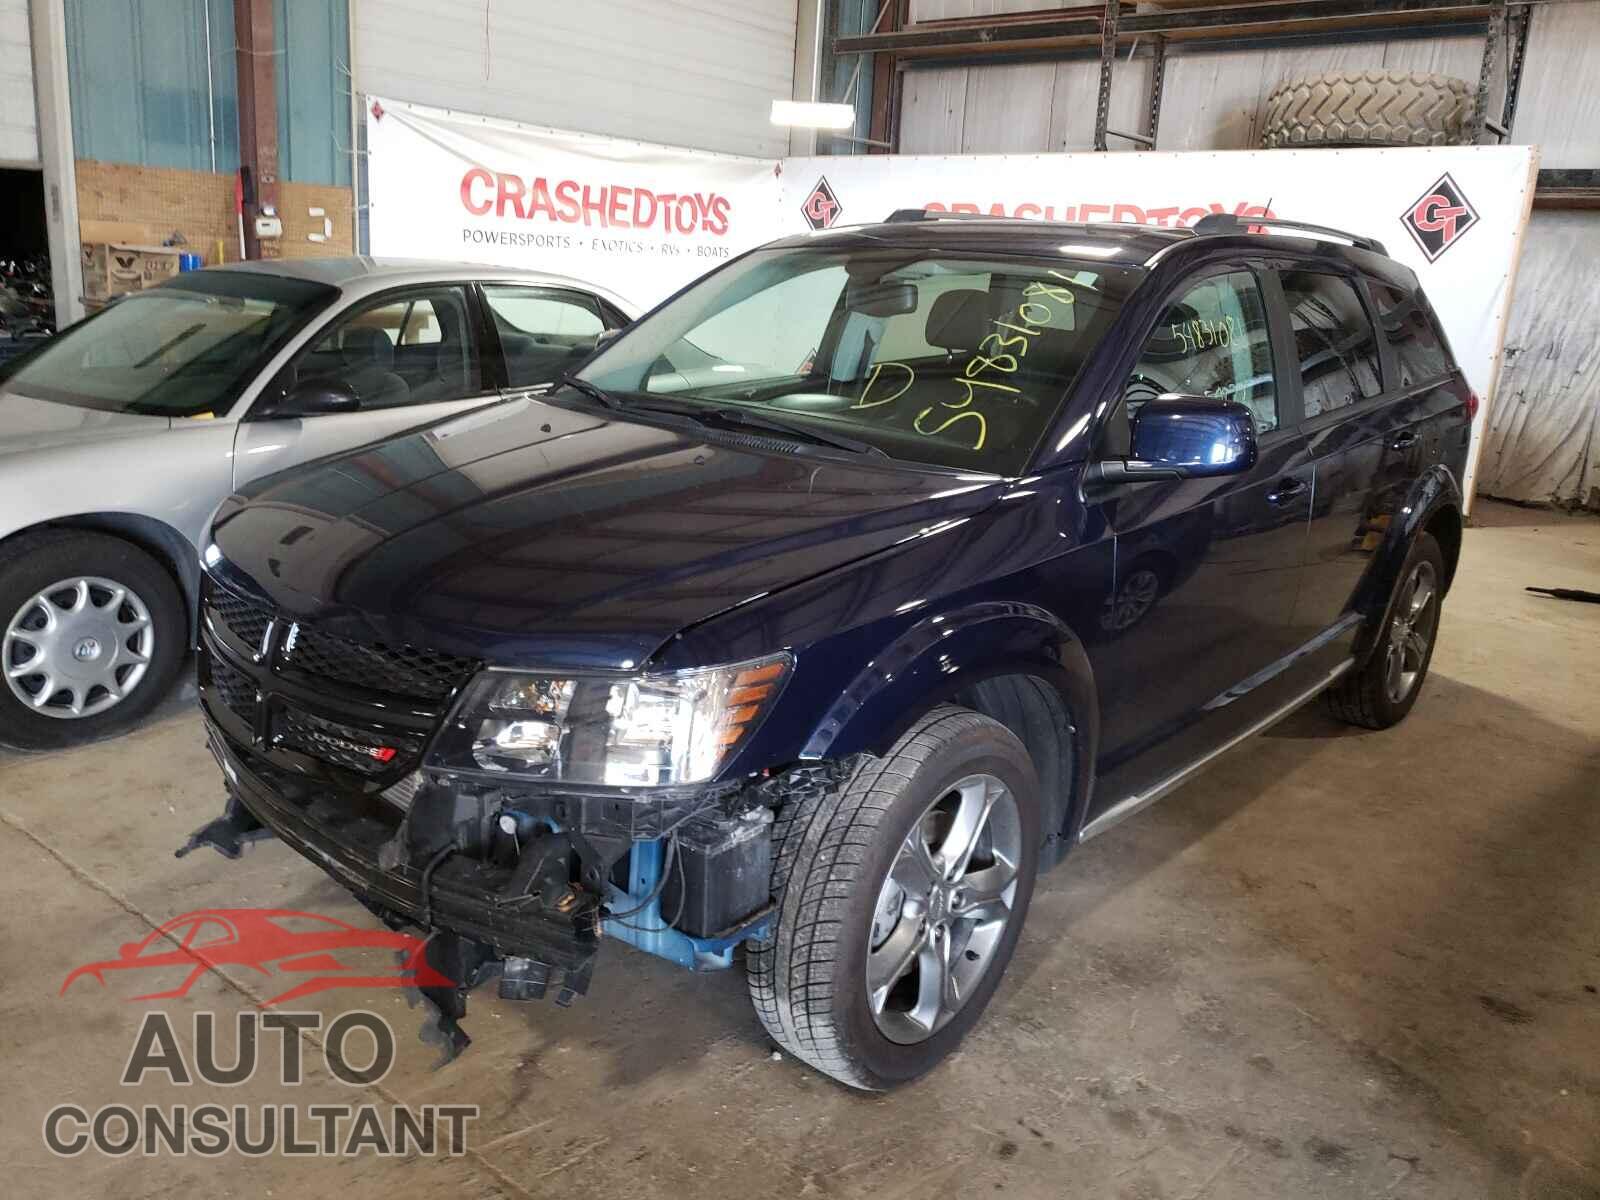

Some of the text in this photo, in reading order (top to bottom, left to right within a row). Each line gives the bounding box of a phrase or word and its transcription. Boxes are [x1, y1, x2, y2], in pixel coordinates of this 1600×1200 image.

[460, 167, 731, 236] CRASHEDTOYS
[462, 228, 571, 249] POWERSPORTS
[591, 238, 644, 254] EXOTICS
[696, 245, 730, 258] BOATS
